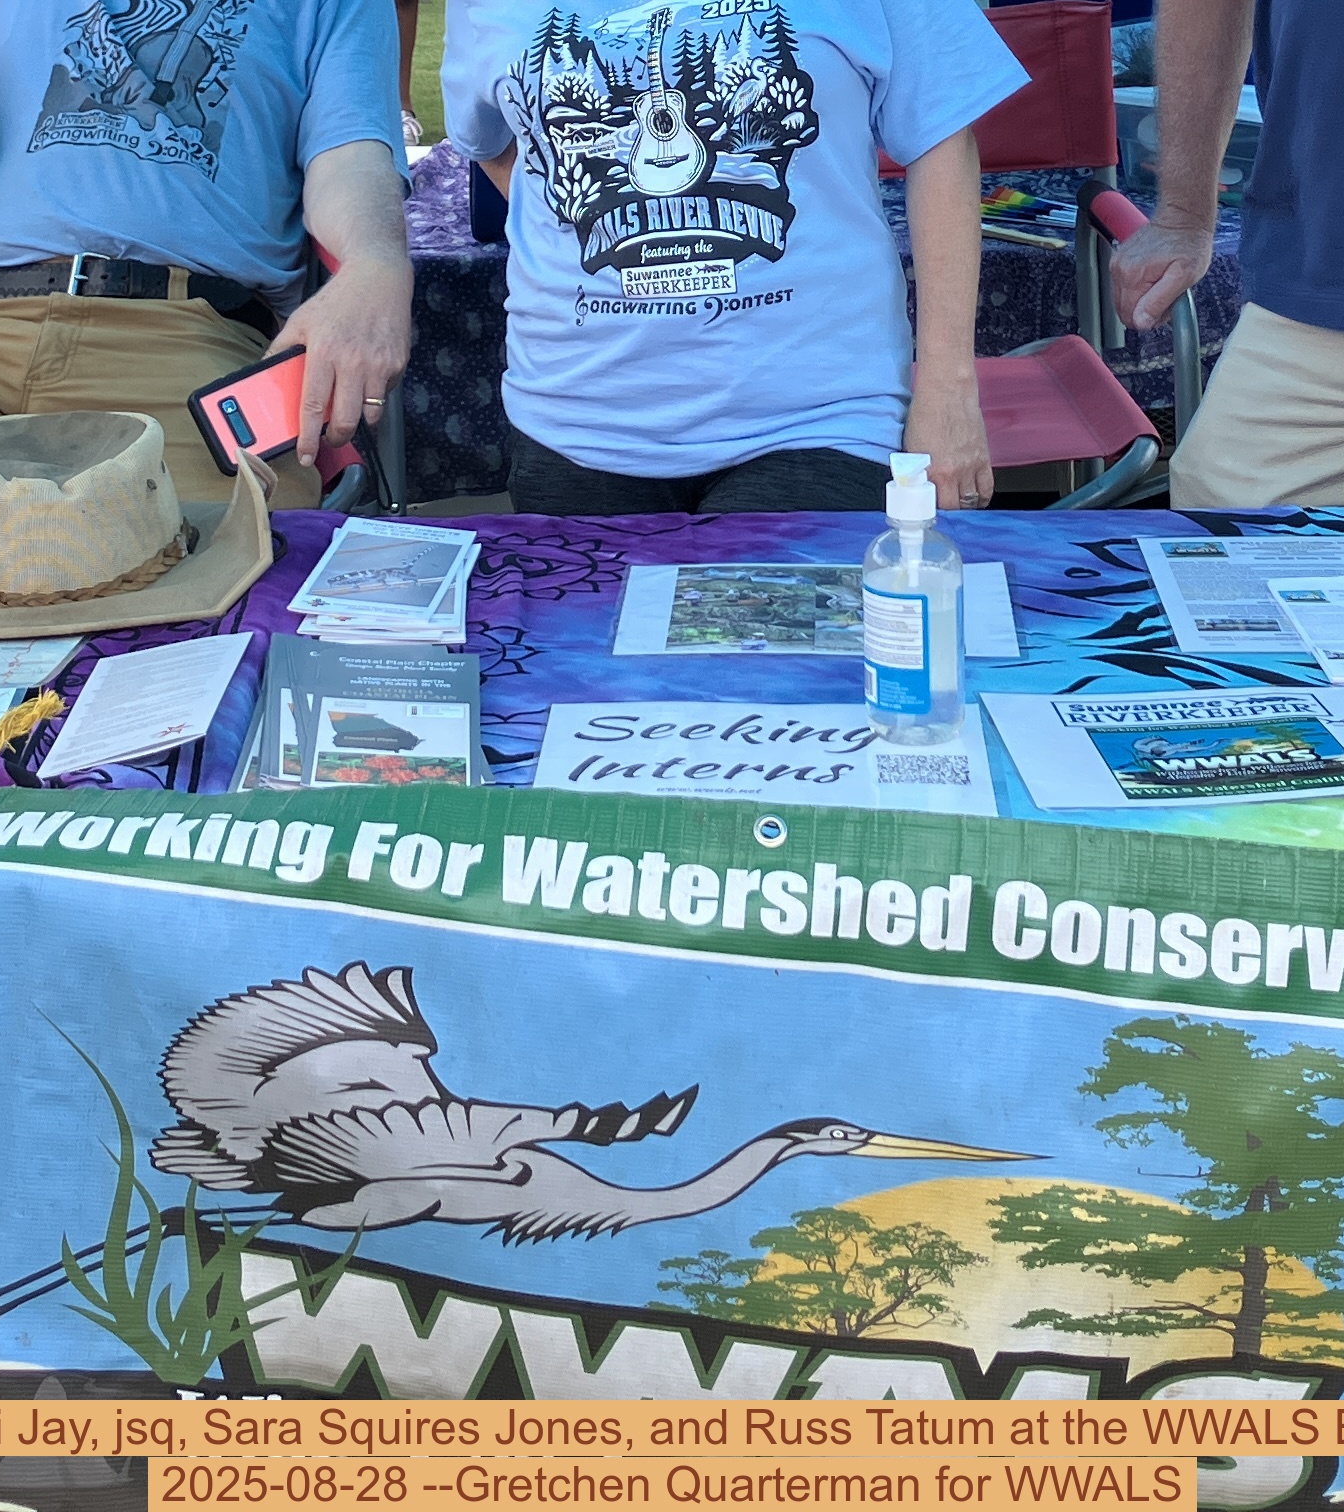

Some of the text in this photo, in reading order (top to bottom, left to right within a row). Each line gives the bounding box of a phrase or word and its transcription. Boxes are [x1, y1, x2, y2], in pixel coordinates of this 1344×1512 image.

[645, 196, 712, 230] RIVER
[716, 197, 785, 251] REVUE
[640, 239, 714, 264] featuring the
[624, 274, 734, 297] RIVERKEEPER
[626, 266, 692, 282] Suwannee
[339, 656, 383, 665] Coastal
[418, 660, 466, 668] Chapter
[1068, 699, 1222, 713] Suwannee
[573, 714, 885, 754] Seeking
[568, 754, 856, 785] Interns
[1153, 748, 1320, 772] WWALS
[1126, 787, 1194, 796] WWALS
[1197, 781, 1287, 794] Watershed
[346, 821, 482, 897] For
[501, 835, 974, 953] Watershed
